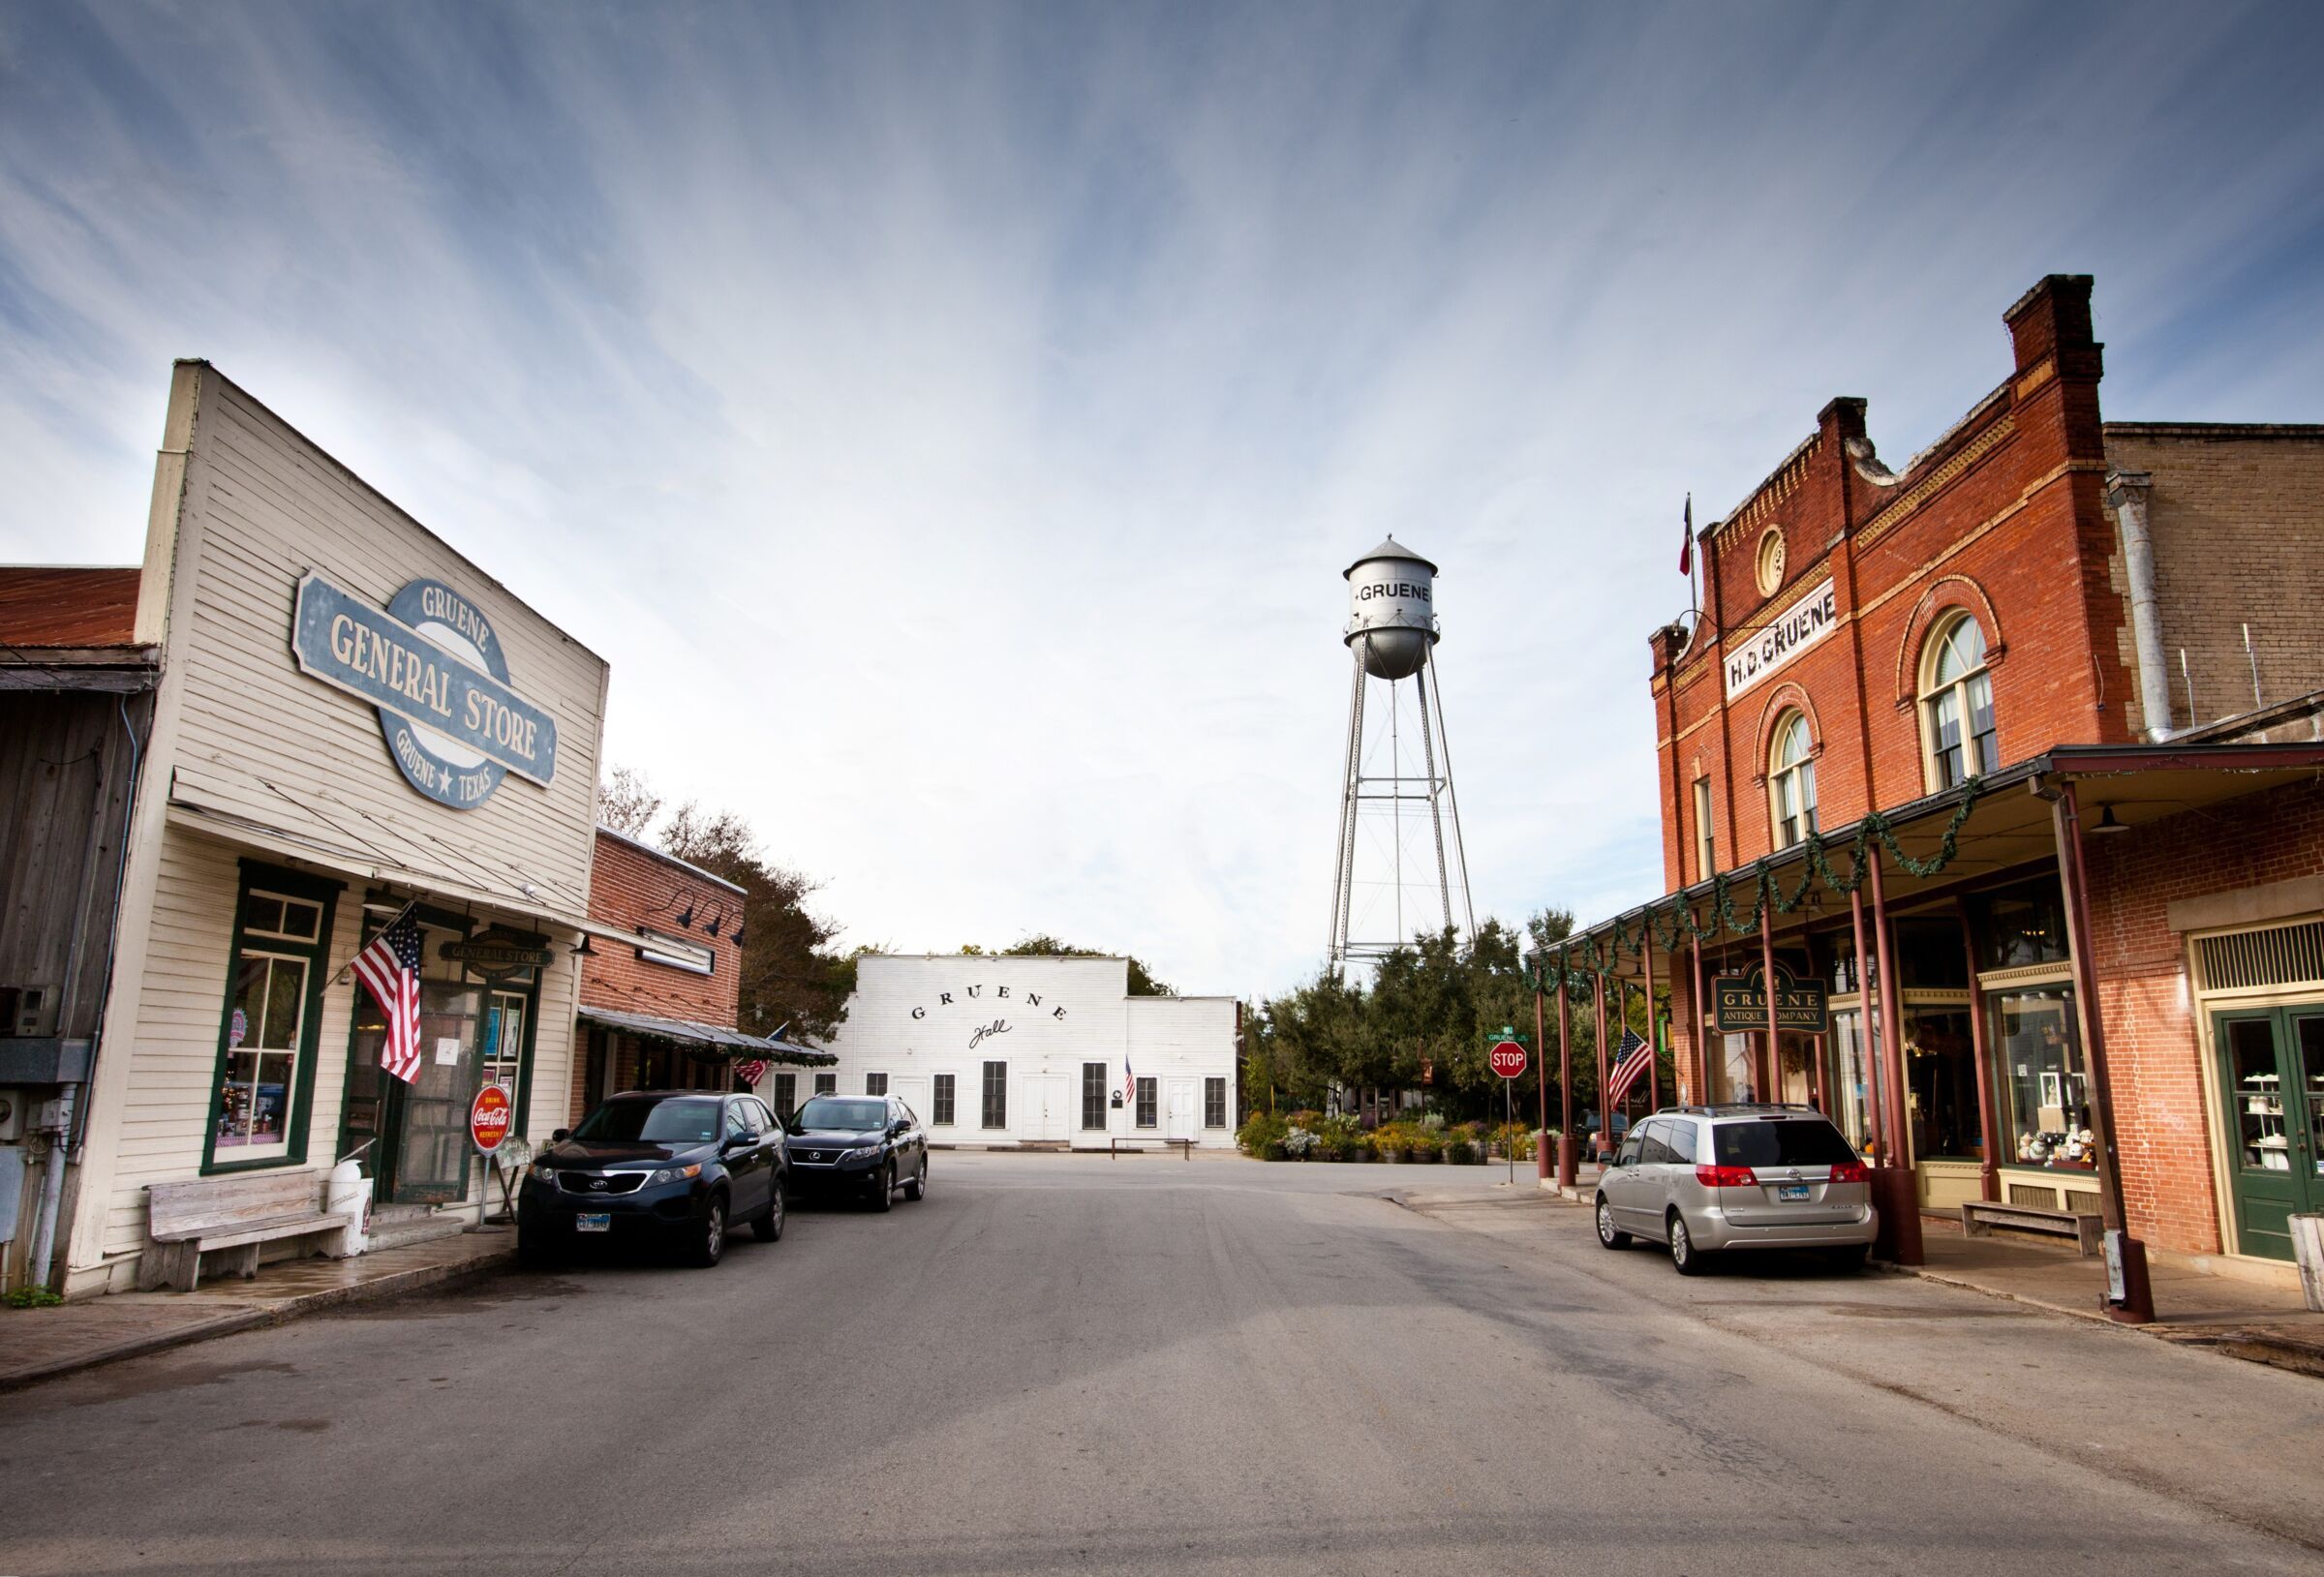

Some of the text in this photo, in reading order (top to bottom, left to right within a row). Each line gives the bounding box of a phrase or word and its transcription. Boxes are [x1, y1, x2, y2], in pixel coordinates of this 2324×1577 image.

[1361, 583, 1429, 602] GRUENE
[422, 587, 489, 653] GRUENE
[1762, 591, 1835, 664] GRUENE
[330, 613, 537, 761] GENERAL STORE
[397, 728, 491, 802] GRUENE TEXAS
[451, 947, 542, 963] GENERAL STORE
[911, 985, 1066, 1020] GRUENE
[1724, 993, 1818, 1006] GRUENE
[1724, 1011, 1819, 1021] ANTIQUE OMPANY
[969, 1019, 1013, 1049] Hall
[1493, 1052, 1524, 1067] STOP
